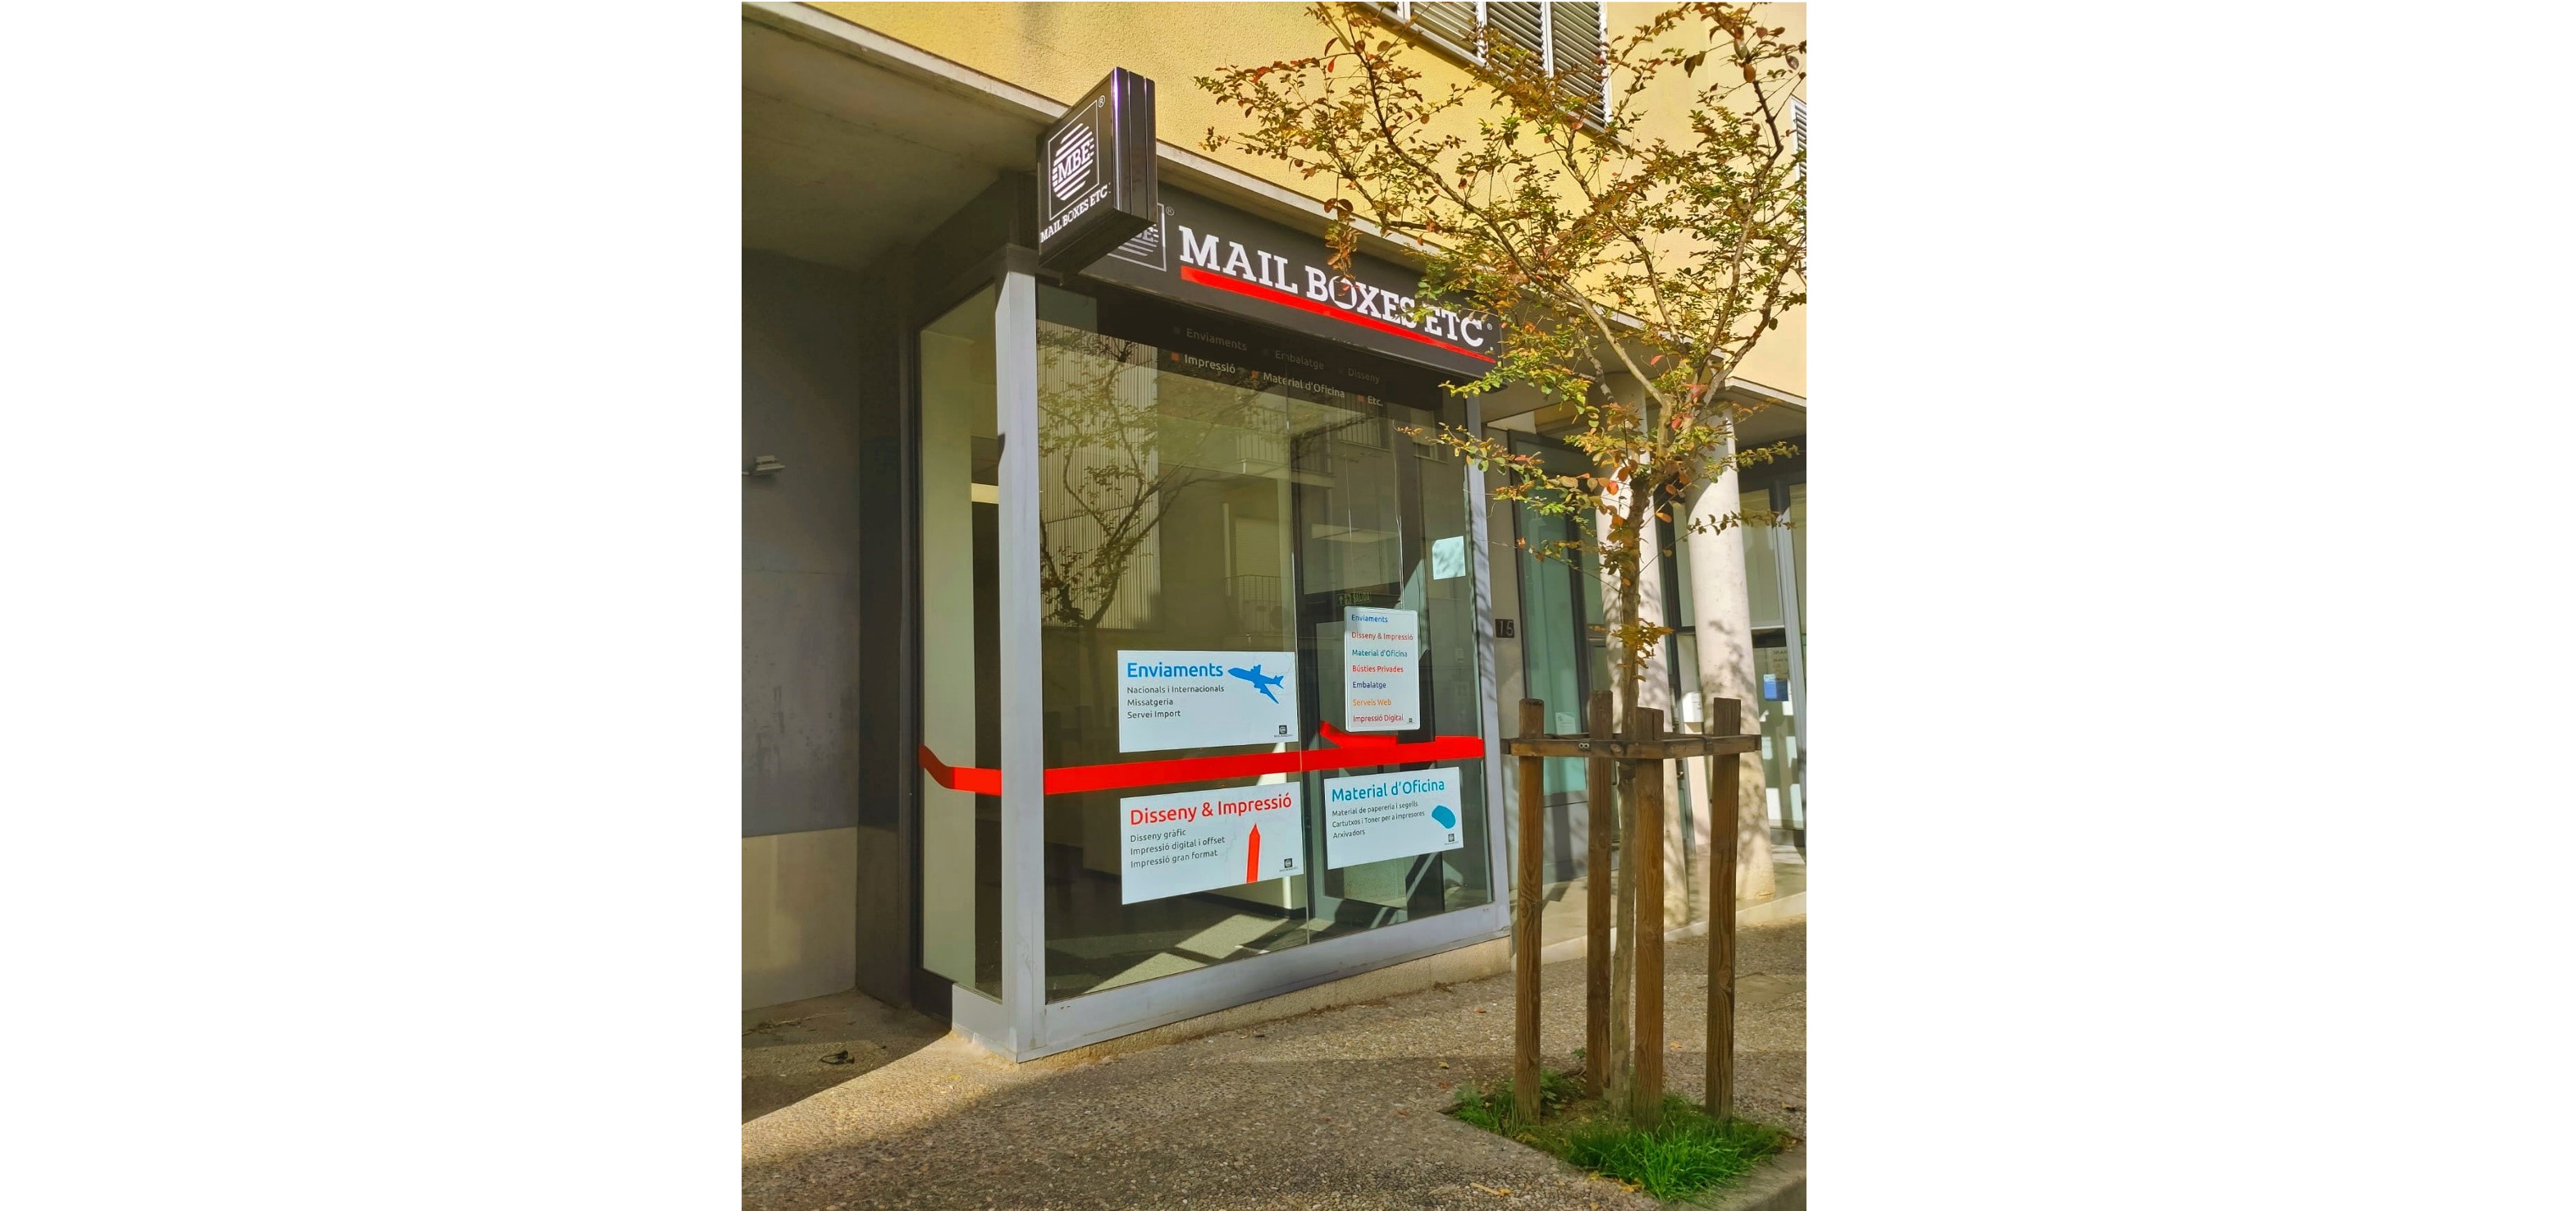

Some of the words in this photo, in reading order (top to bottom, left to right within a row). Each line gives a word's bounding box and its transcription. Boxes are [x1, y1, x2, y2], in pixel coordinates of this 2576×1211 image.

[1057, 140, 1091, 183] MBE
[1039, 219, 1062, 243] MAIL
[1062, 199, 1089, 227] BOXES
[1178, 225, 1299, 294] MAIL
[1304, 264, 1418, 329] BOXES
[1186, 327, 1247, 351] Enviaments
[1184, 354, 1236, 374] Impressió
[1275, 350, 1324, 370] Embalatge
[1263, 372, 1304, 390] Material
[1347, 368, 1380, 385] Disseny
[1368, 395, 1384, 407] Etc.
[1351, 614, 1388, 623] Enviaments
[1351, 632, 1376, 641] Disseny
[1383, 632, 1414, 642] Impressió
[1499, 621, 1514, 637] 15
[1380, 648, 1408, 657] d'Oficina
[1126, 661, 1223, 679] Enviaments
[1352, 664, 1376, 673] Bústies
[1126, 686, 1166, 694] Nacionals
[1172, 684, 1225, 692] Internacionals
[1352, 681, 1386, 690] Embalatge
[1127, 697, 1174, 707] Missatgeria
[1127, 711, 1153, 719] Servei
[1154, 710, 1181, 719] Import
[1353, 714, 1383, 723] Impressió
[1384, 713, 1404, 722] Digital
[1331, 784, 1388, 802] Material
[1391, 779, 1445, 796] d'Oficina
[1130, 807, 1197, 825] Disseny
[1202, 802, 1213, 817] &
[1218, 793, 1292, 816] Impressió
[1331, 808, 1358, 816] Material
[1368, 803, 1395, 814] papereria
[1399, 800, 1418, 810] segells
[1331, 819, 1361, 828] Cartutxos
[1382, 815, 1391, 823] per
[1395, 810, 1425, 820] impresores
[1130, 833, 1162, 843] Disseny
[1163, 828, 1186, 840] gràfic
[1332, 829, 1366, 839] Arxivadors
[1130, 842, 1170, 856] Impressió
[1172, 839, 1197, 850] digital
[1202, 836, 1226, 846] offset
[1130, 855, 1170, 869] Impressió
[1172, 855, 1190, 864] gran
[1191, 849, 1218, 860] format
